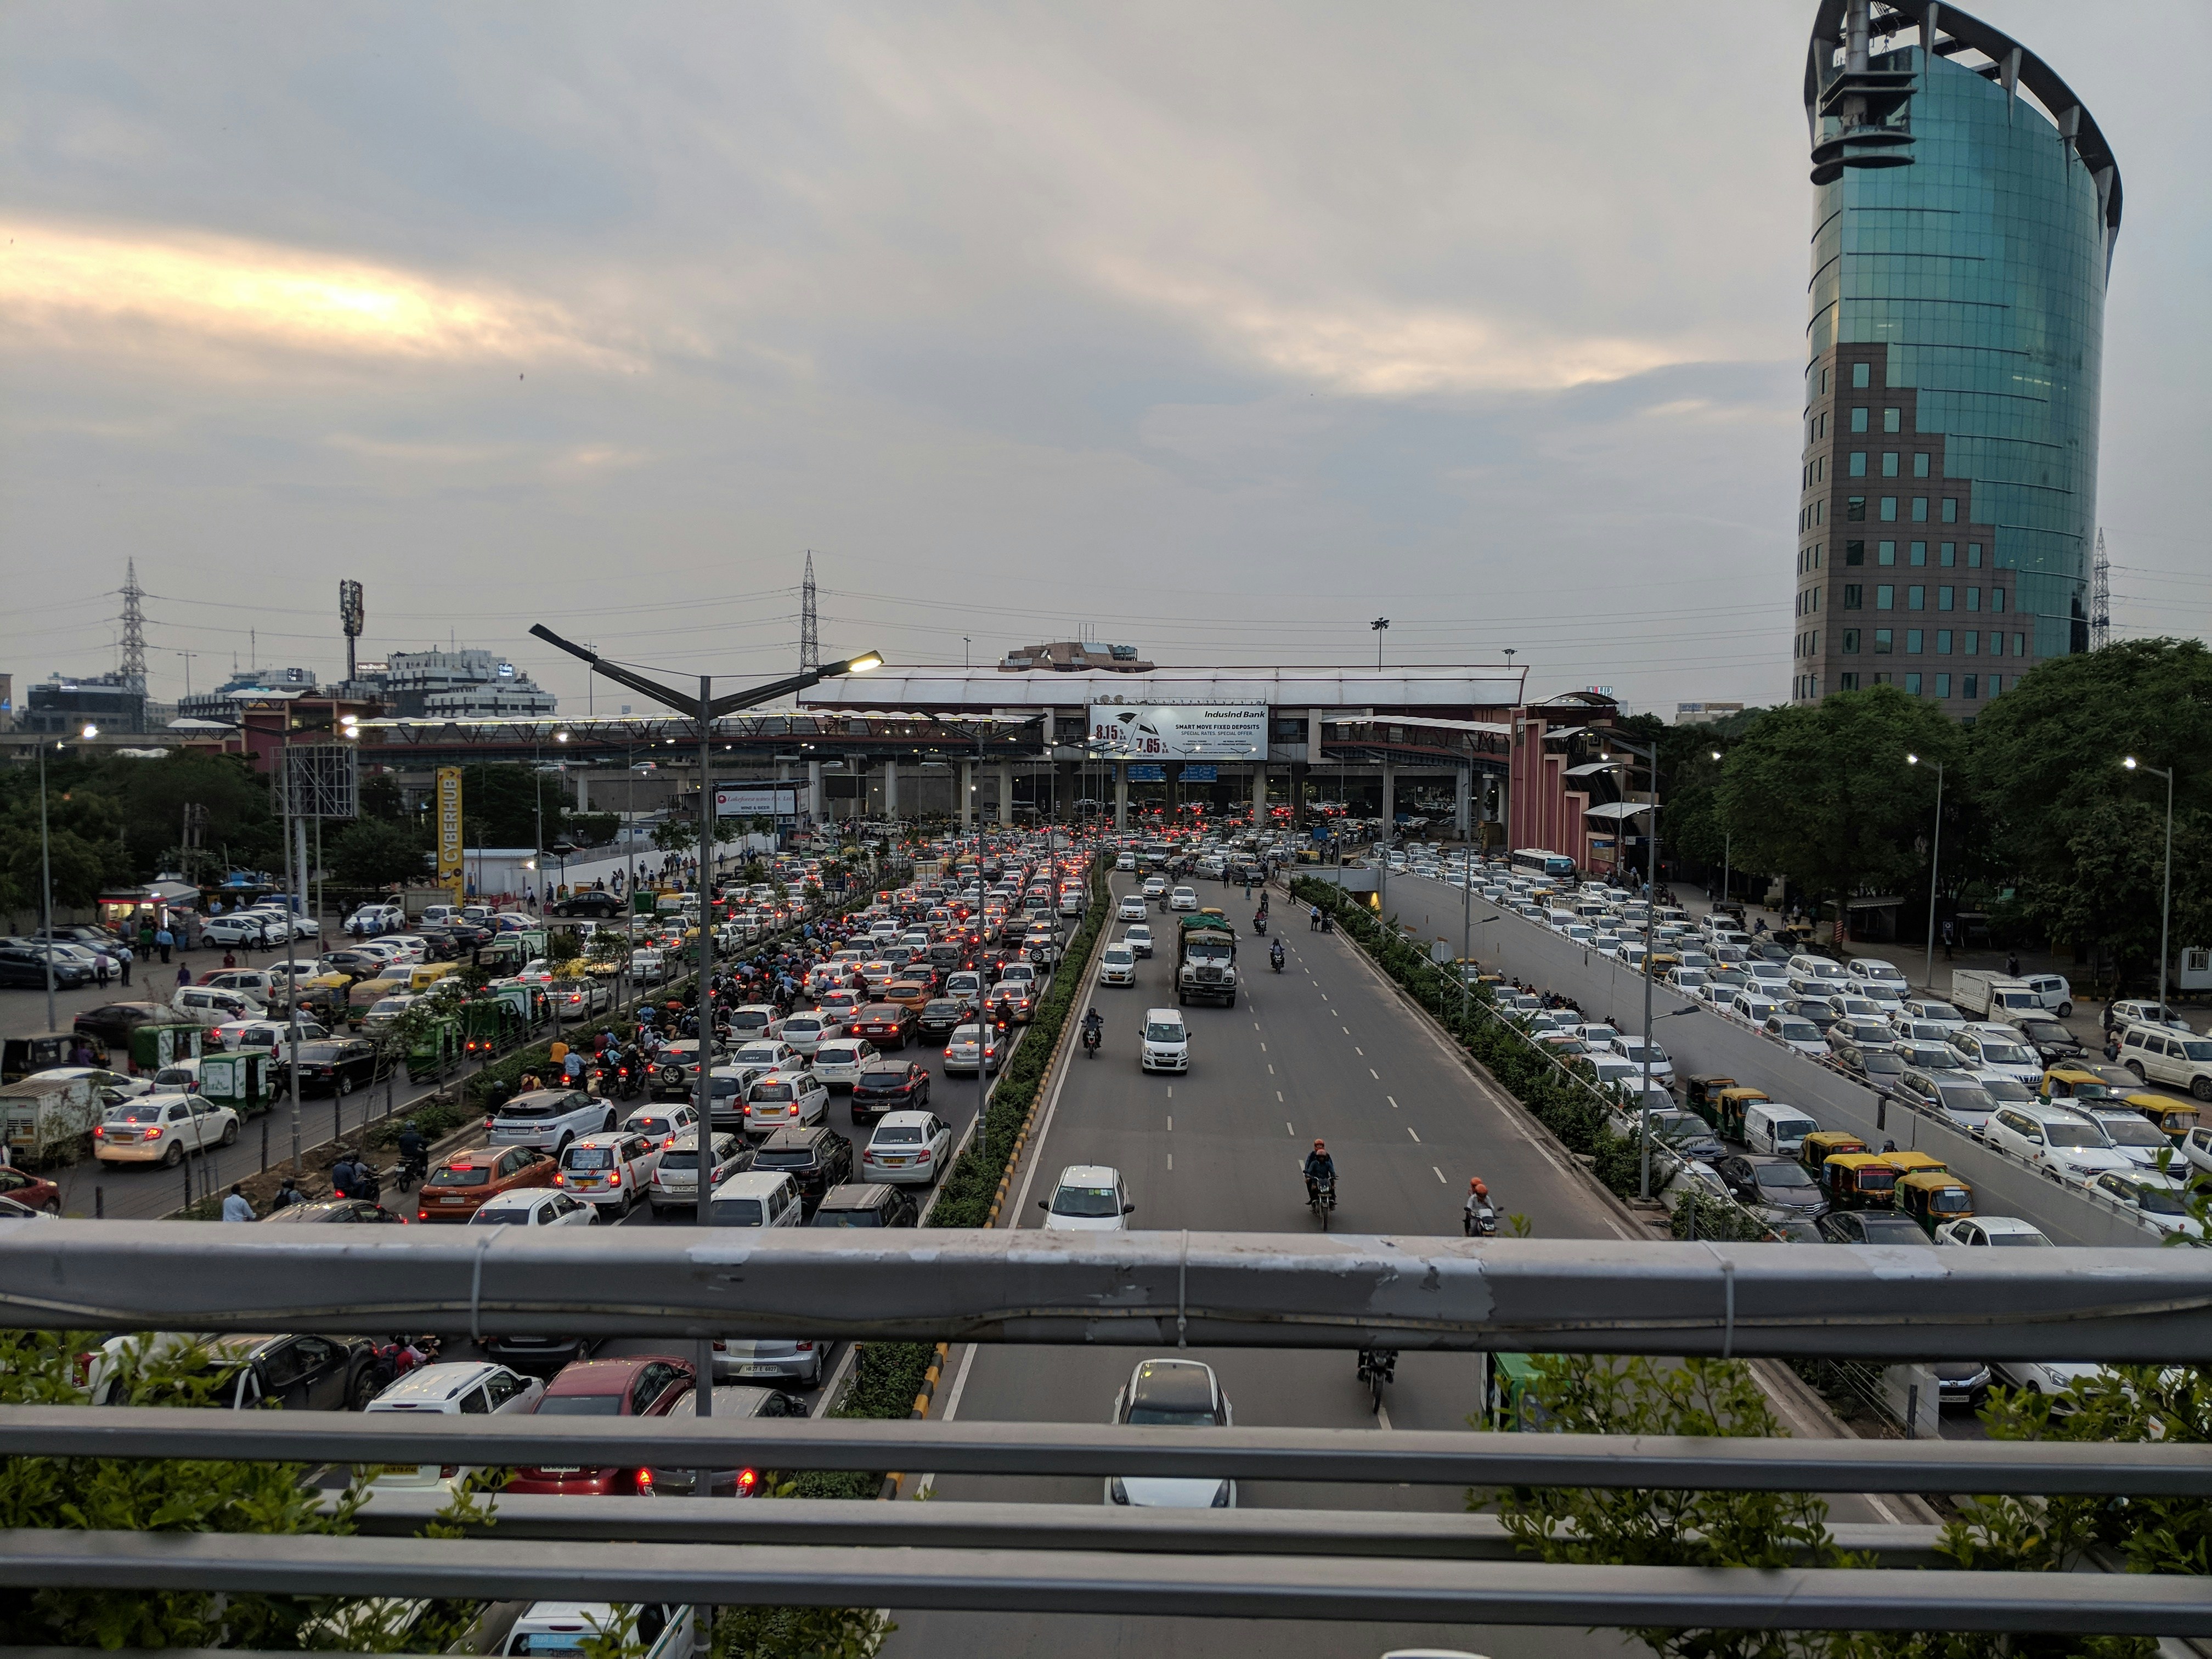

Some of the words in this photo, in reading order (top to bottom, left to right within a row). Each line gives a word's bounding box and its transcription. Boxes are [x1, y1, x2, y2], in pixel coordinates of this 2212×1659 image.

[1096, 724, 1118, 740] 8.15
[1136, 738, 1160, 753] 7.65
[443, 779, 458, 862] CYBERHUB
